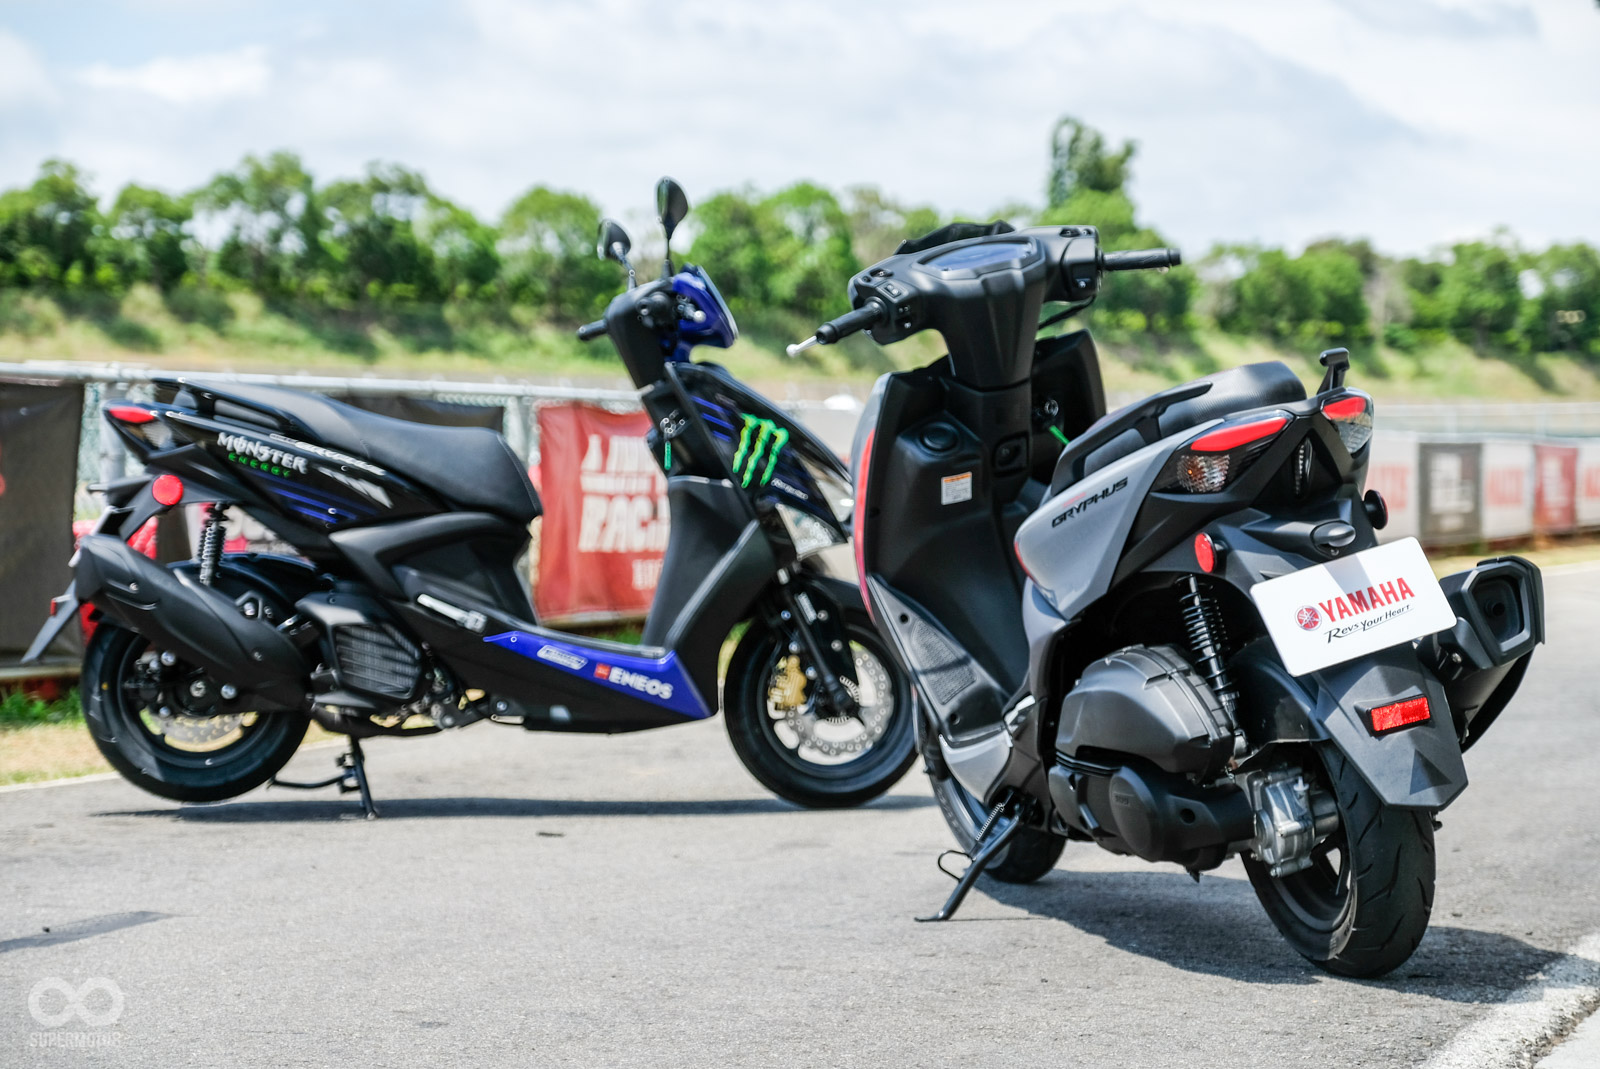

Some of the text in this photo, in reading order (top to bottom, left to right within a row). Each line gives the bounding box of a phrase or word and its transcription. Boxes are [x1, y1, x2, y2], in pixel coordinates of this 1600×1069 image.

[228, 452, 291, 478] ENERGY
[1052, 476, 1128, 528] GRYPHUS
[1318, 577, 1415, 623] YAMAHA
[1323, 604, 1411, 644] Revs Your Heart
[608, 666, 673, 700] ENEOS
